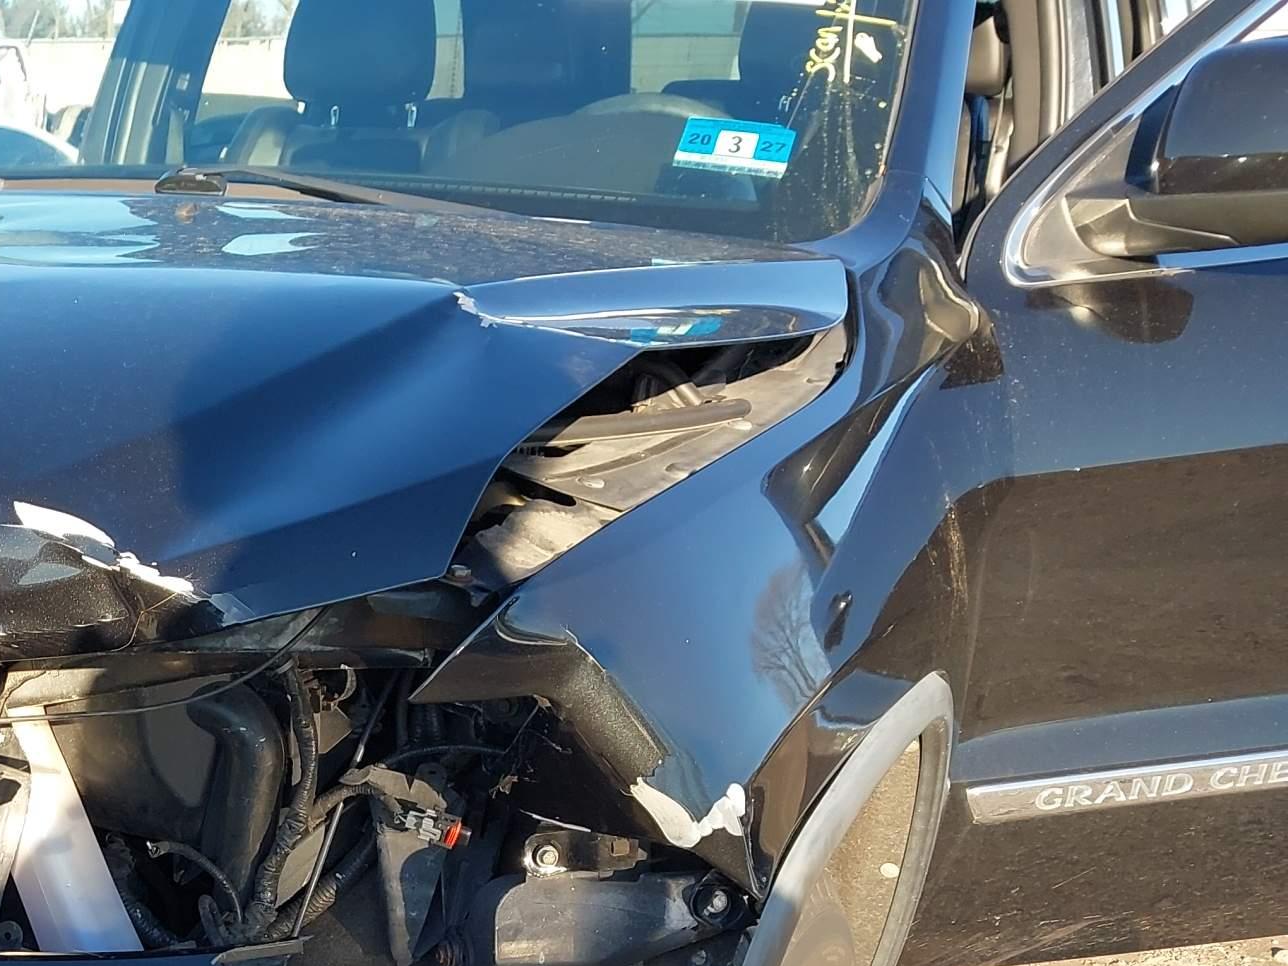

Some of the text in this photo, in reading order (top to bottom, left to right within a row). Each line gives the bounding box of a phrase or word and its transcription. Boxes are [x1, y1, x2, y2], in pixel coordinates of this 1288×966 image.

[687, 132, 787, 154] 20 3 27
[1035, 773, 1194, 811] GRAND
